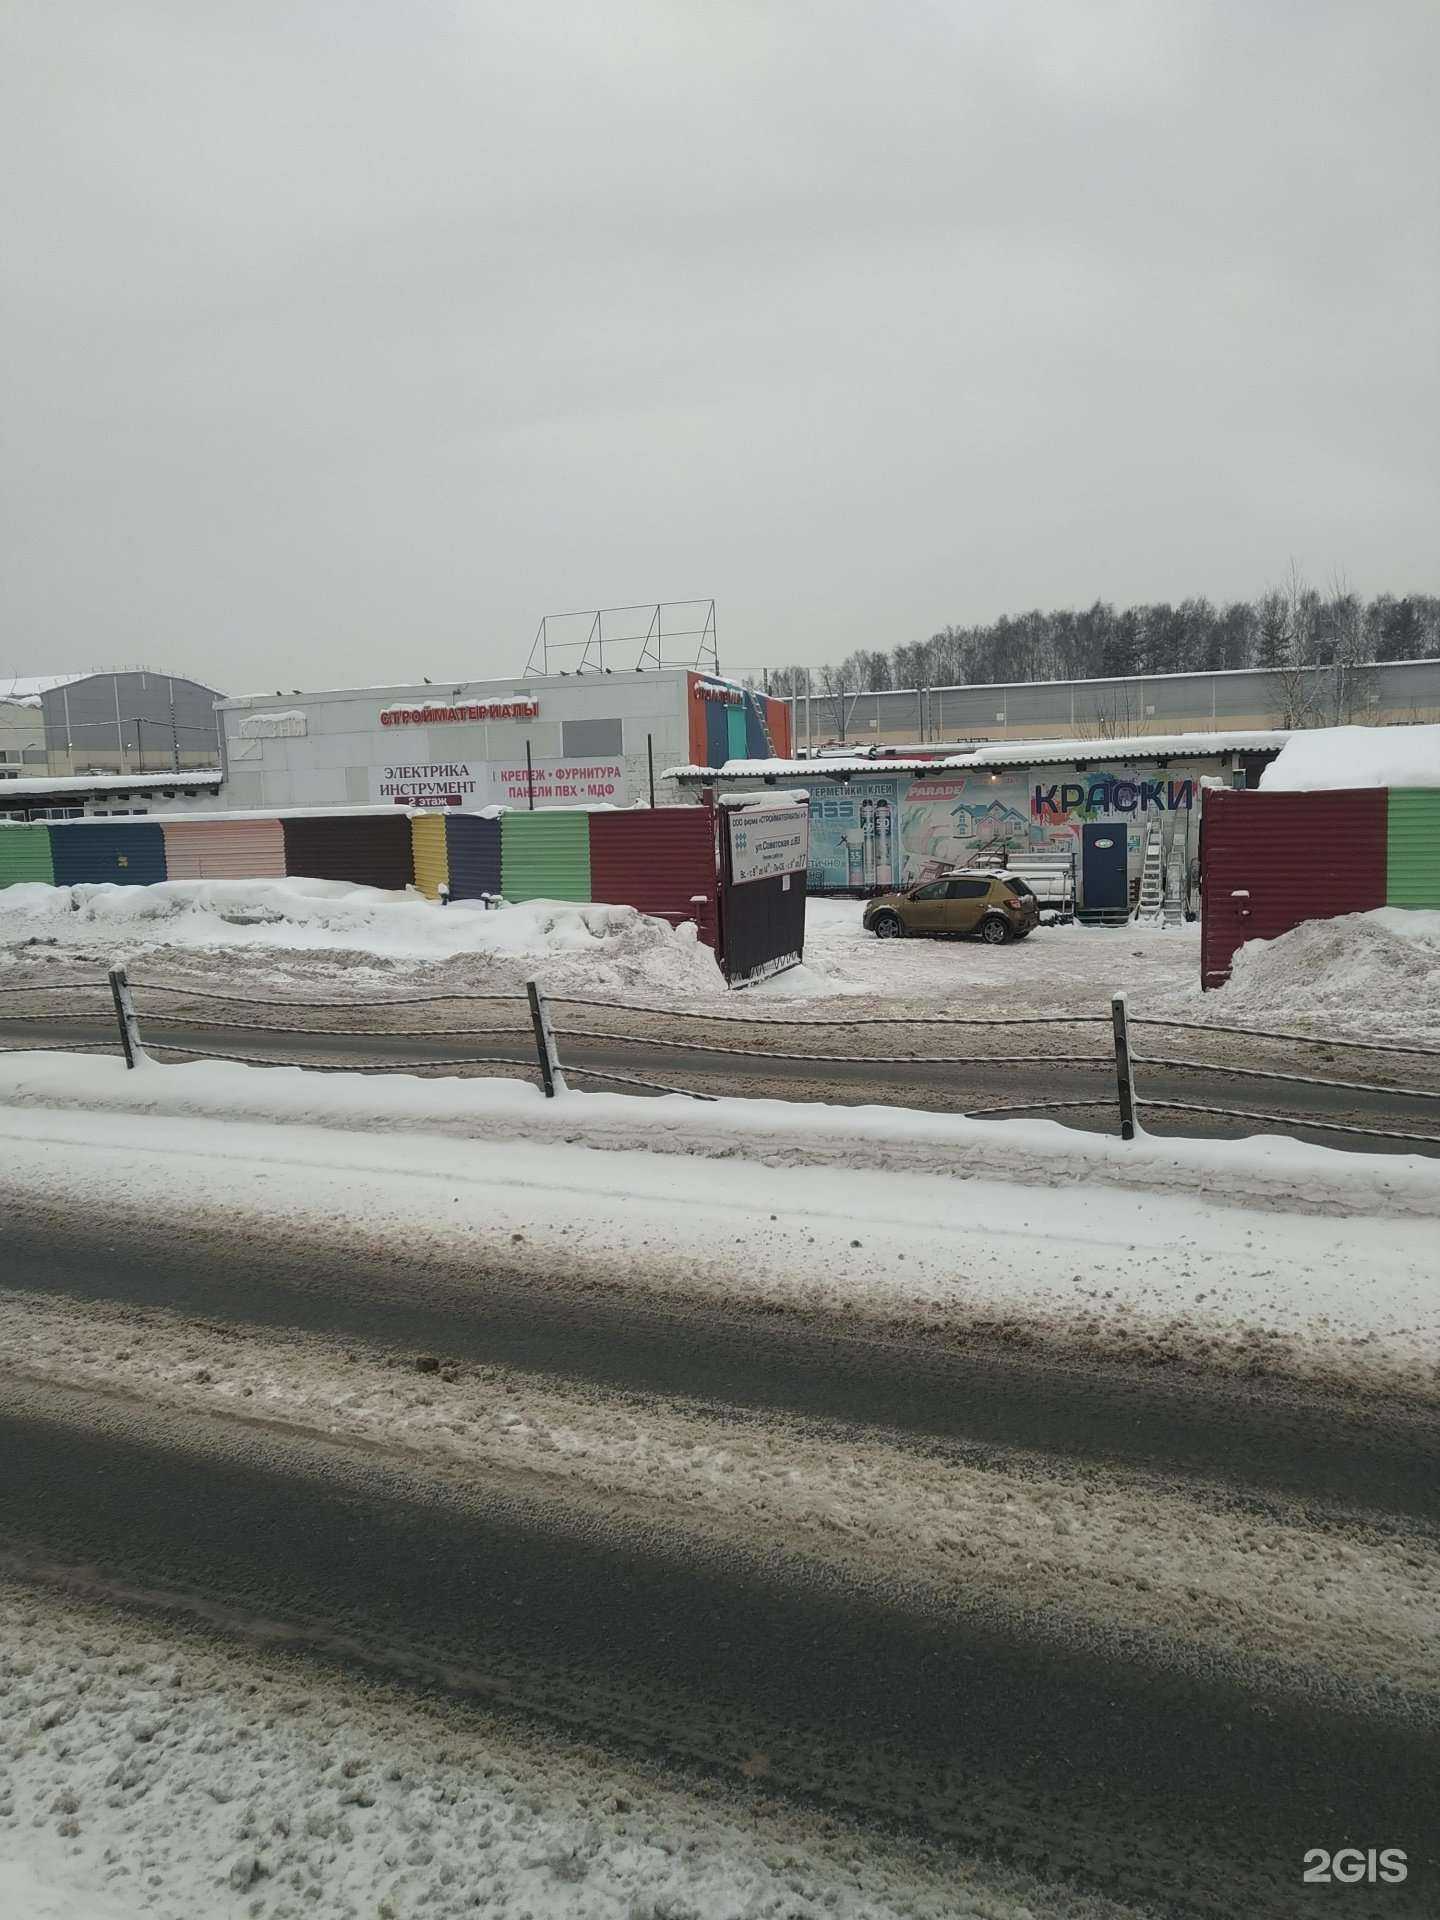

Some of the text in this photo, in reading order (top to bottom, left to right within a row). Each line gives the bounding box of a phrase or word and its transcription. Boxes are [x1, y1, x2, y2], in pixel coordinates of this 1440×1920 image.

[380, 702, 539, 726] СТРОЙМАТЕРИАЛЫ
[384, 764, 470, 779] ЭЛЕКТРИКА
[501, 766, 622, 782] КРЕПЕЖ ФУРНИТУРА
[379, 781, 476, 796] ИНСТРУМЕНТ
[508, 784, 615, 798] ПАНЕЛИ ПВХ МДФ
[408, 796, 448, 807] 2 этаж
[1035, 779, 1193, 814] КРАСКИ
